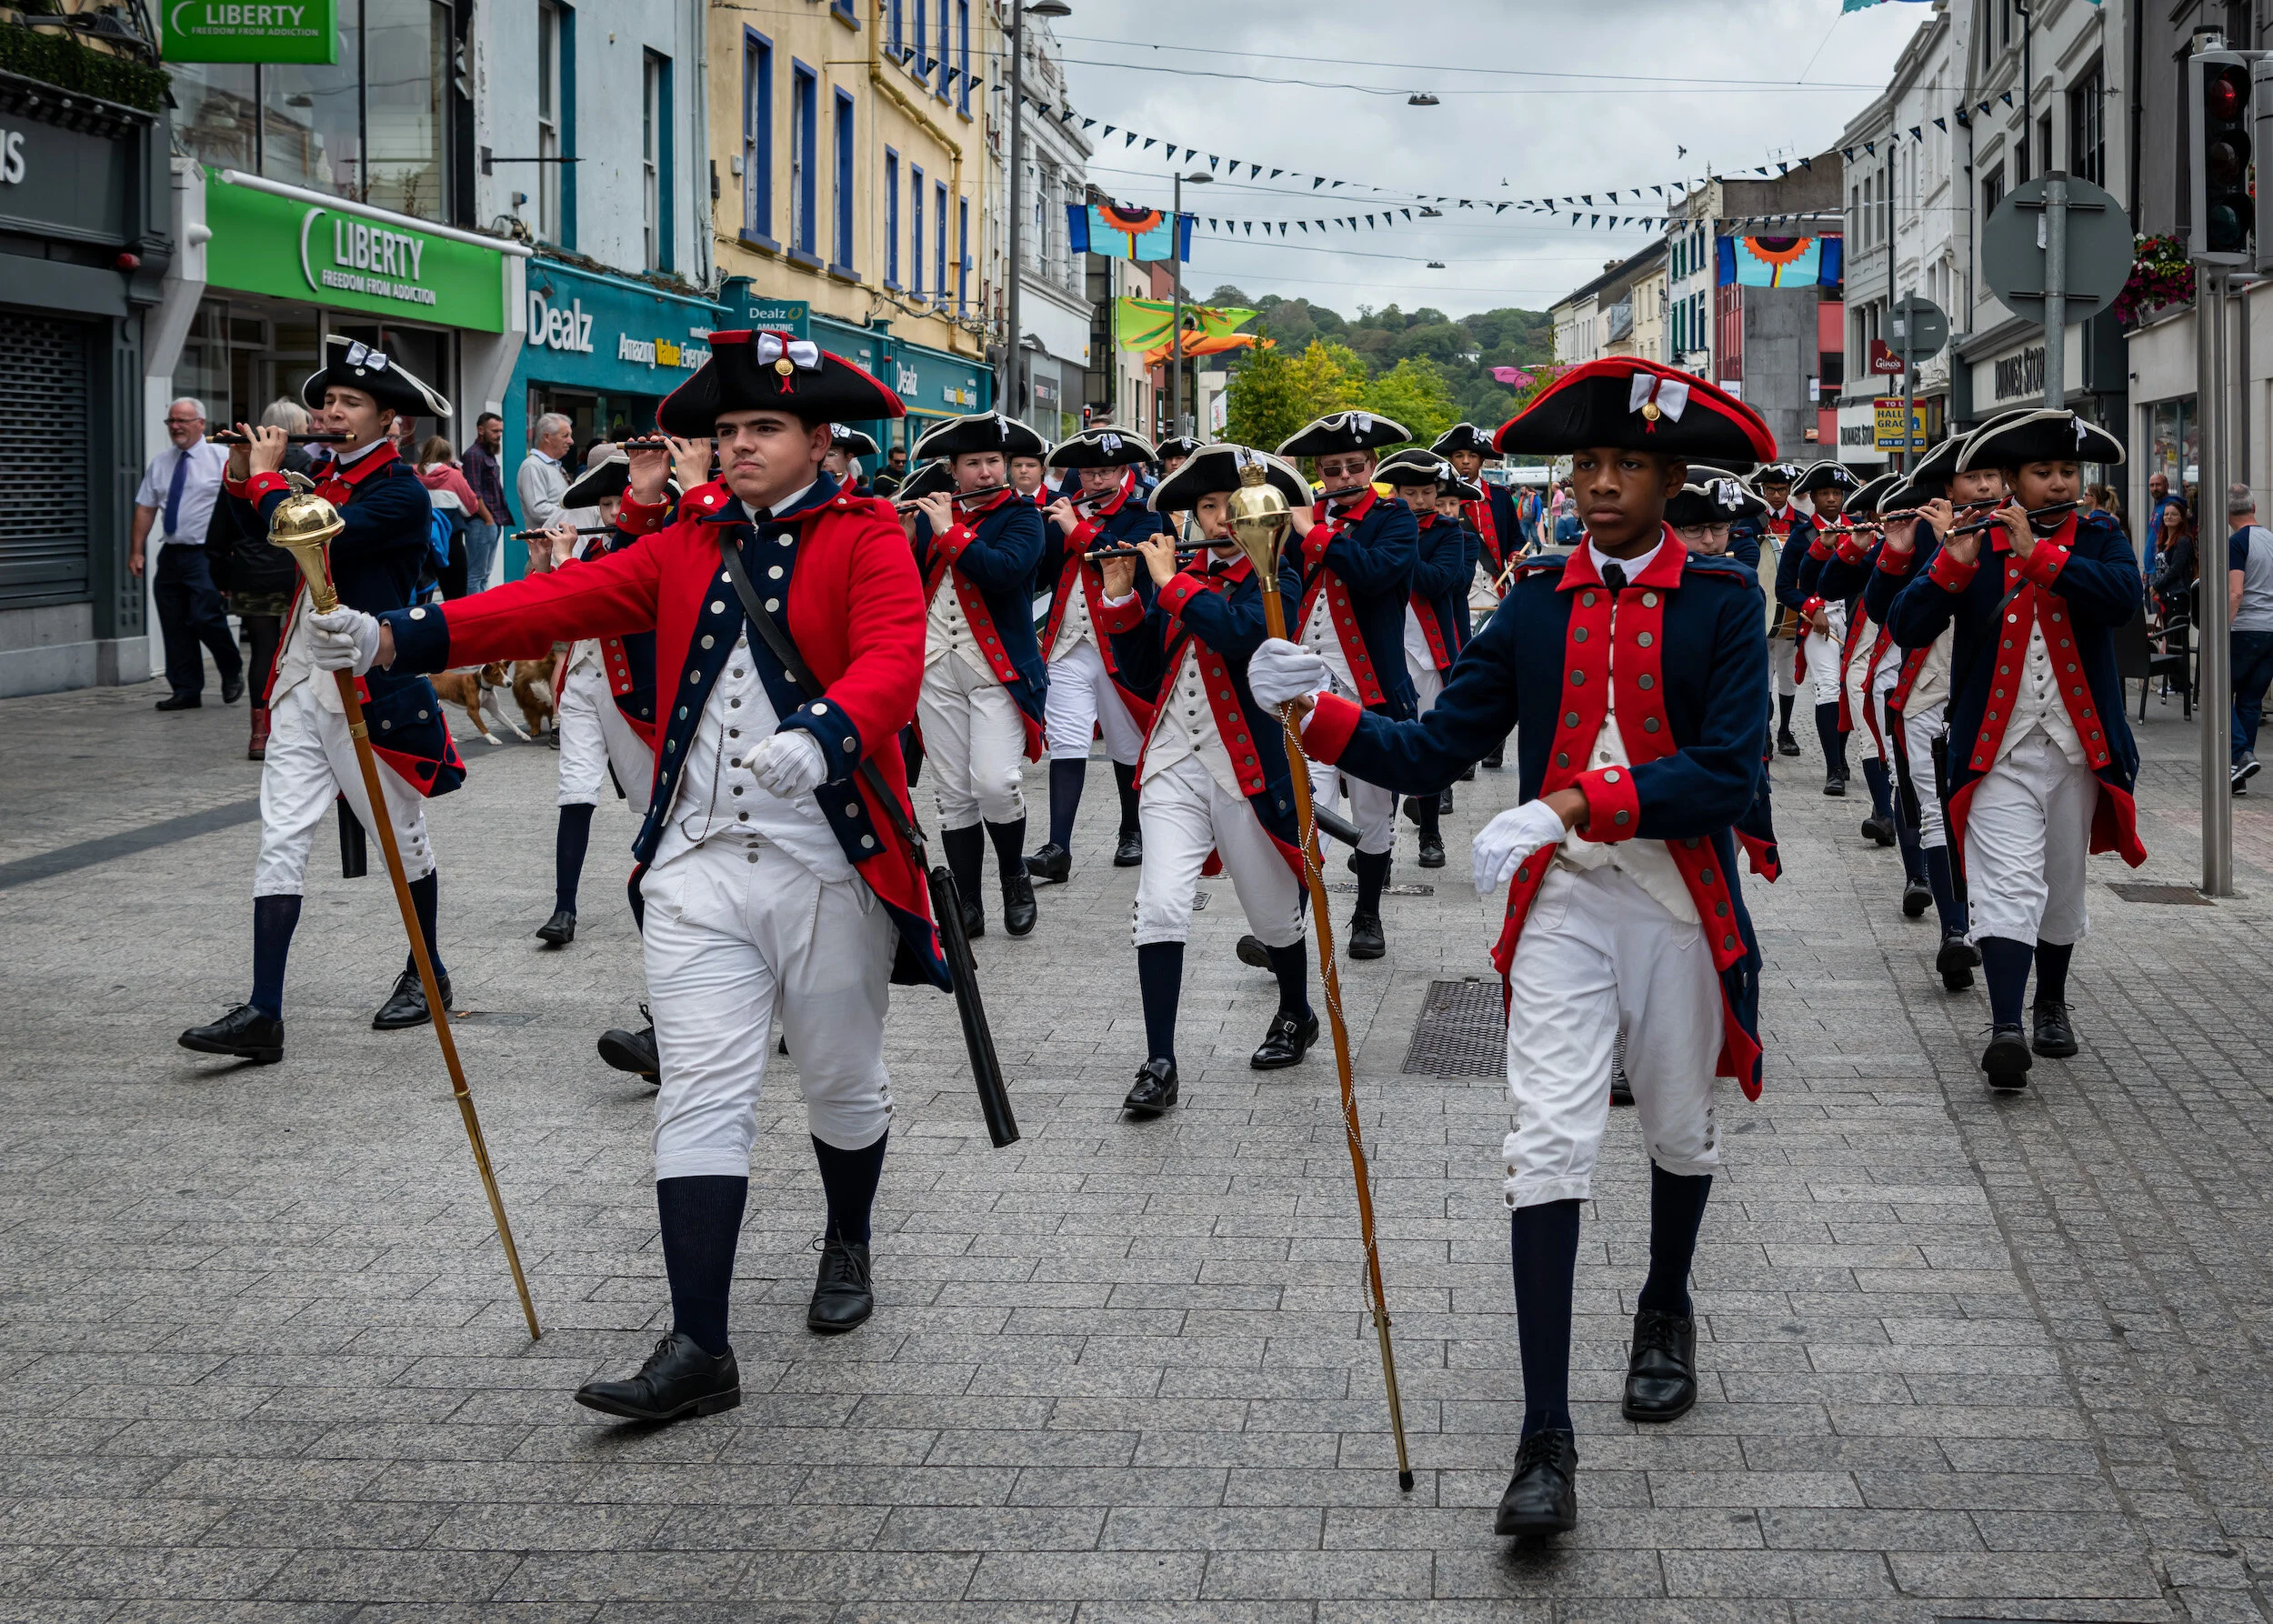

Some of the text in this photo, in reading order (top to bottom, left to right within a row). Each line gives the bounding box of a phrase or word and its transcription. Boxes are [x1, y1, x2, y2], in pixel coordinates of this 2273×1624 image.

[205, 4, 305, 26] LIBERTY
[191, 26, 319, 36] FREEDOM FROM ADDICTION
[334, 218, 424, 281] LIBERTY
[322, 269, 436, 306] FREEDOM FROM ADDICTION
[527, 289, 594, 354] Dealz
[749, 307, 786, 319] Dealz
[757, 323, 794, 332] AMAZING
[618, 332, 656, 369] Amazing
[655, 337, 681, 366] Value
[1876, 357, 1901, 368] Gino's
[896, 361, 917, 396] Dealz
[2024, 346, 2045, 394] STOR
[1877, 410, 1913, 418] HALL
